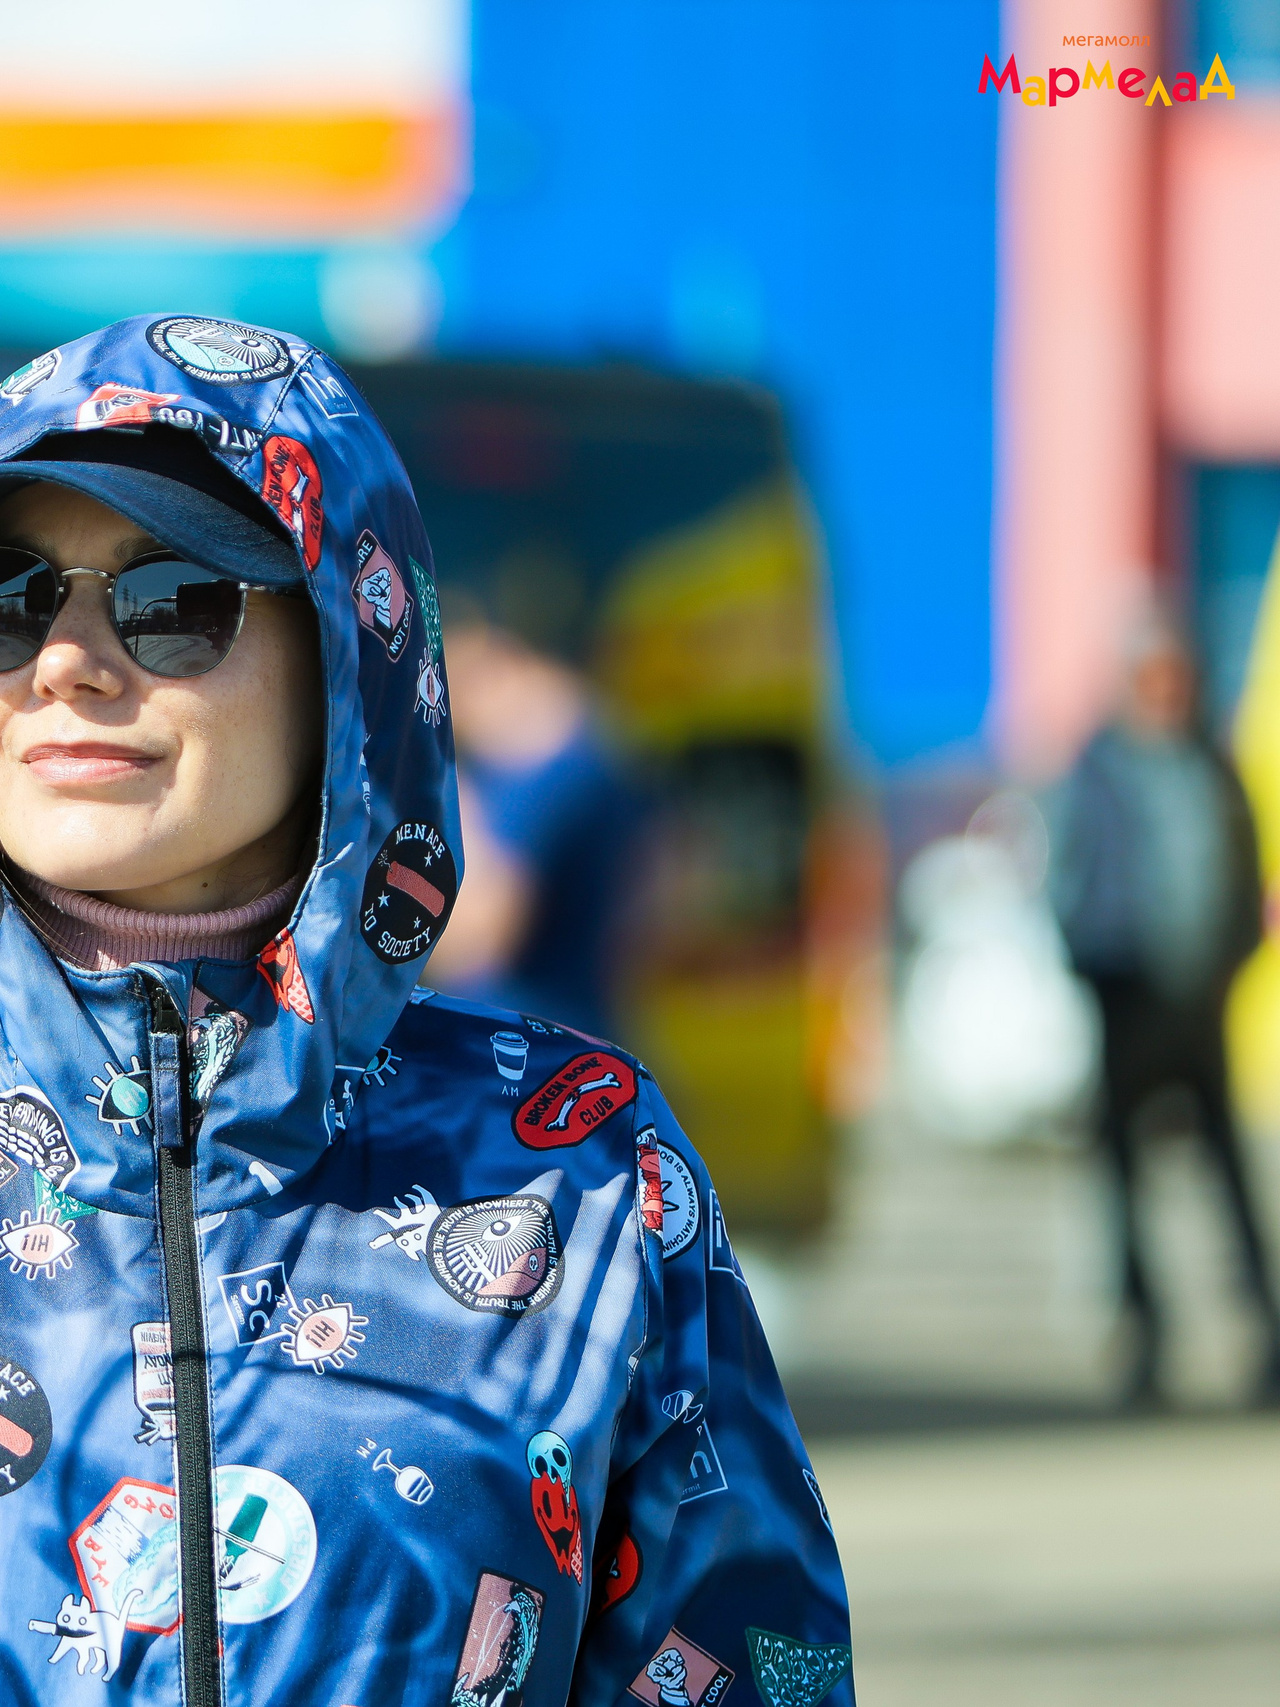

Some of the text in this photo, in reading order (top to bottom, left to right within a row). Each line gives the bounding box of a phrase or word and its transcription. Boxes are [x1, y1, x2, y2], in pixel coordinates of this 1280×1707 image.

[389, 629, 407, 654] NOT
[395, 823, 446, 859] MENACE
[364, 903, 431, 957] TO SOCIETY
[501, 1085, 519, 1097] AM
[523, 1056, 603, 1126] BROKEN BONE
[578, 1095, 615, 1126] CLUB
[49, 1146, 69, 1164] IS
[659, 1150, 695, 1253] OG IS ALWAYS WATCHIN
[433, 1199, 558, 1310] THE TRUTH IS NOWHERE THE TRUTH IS NOWHERE THE TRUTH IS NOWHERE
[356, 1437, 378, 1459] PM
[83, 1534, 109, 1589] BYE
[705, 1674, 729, 1704] COOL
